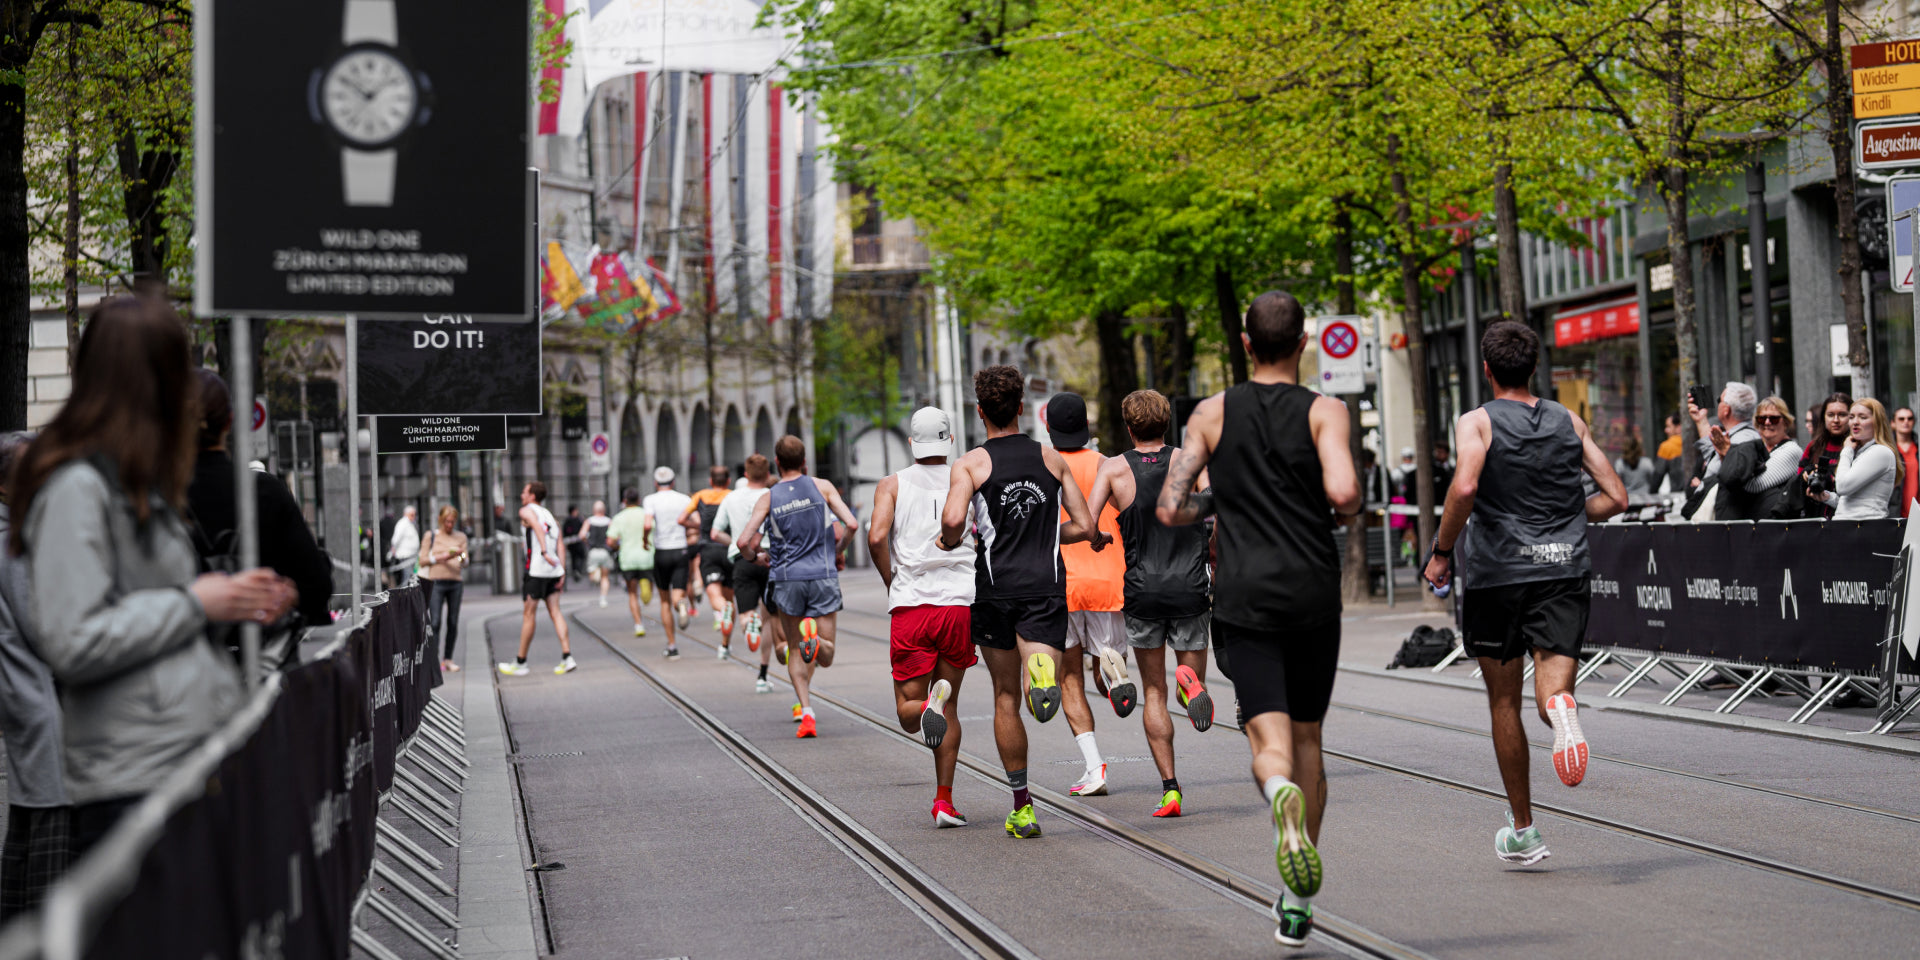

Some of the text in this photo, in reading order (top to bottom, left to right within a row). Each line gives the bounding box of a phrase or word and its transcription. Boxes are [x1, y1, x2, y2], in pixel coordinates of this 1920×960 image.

[1860, 69, 1899, 87] Widder
[1861, 94, 1892, 111] Kindli
[321, 229, 421, 250] WILD ONE
[274, 247, 467, 273] ZÜRICH MARATHON
[287, 274, 454, 295] LIMITED EDITION
[413, 330, 484, 349] DO IT!
[402, 425, 480, 435] ZÜRICH MARATHON
[421, 416, 461, 425] WILD ONE
[408, 434, 475, 443] LIMITED EDITION
[1000, 494, 1007, 506] LG
[1023, 480, 1047, 503] Athletik
[1636, 585, 1672, 611] NORQAIN
[1821, 580, 1829, 603] be
[1832, 580, 1870, 605] NORQAINER
[1873, 589, 1886, 611] your
